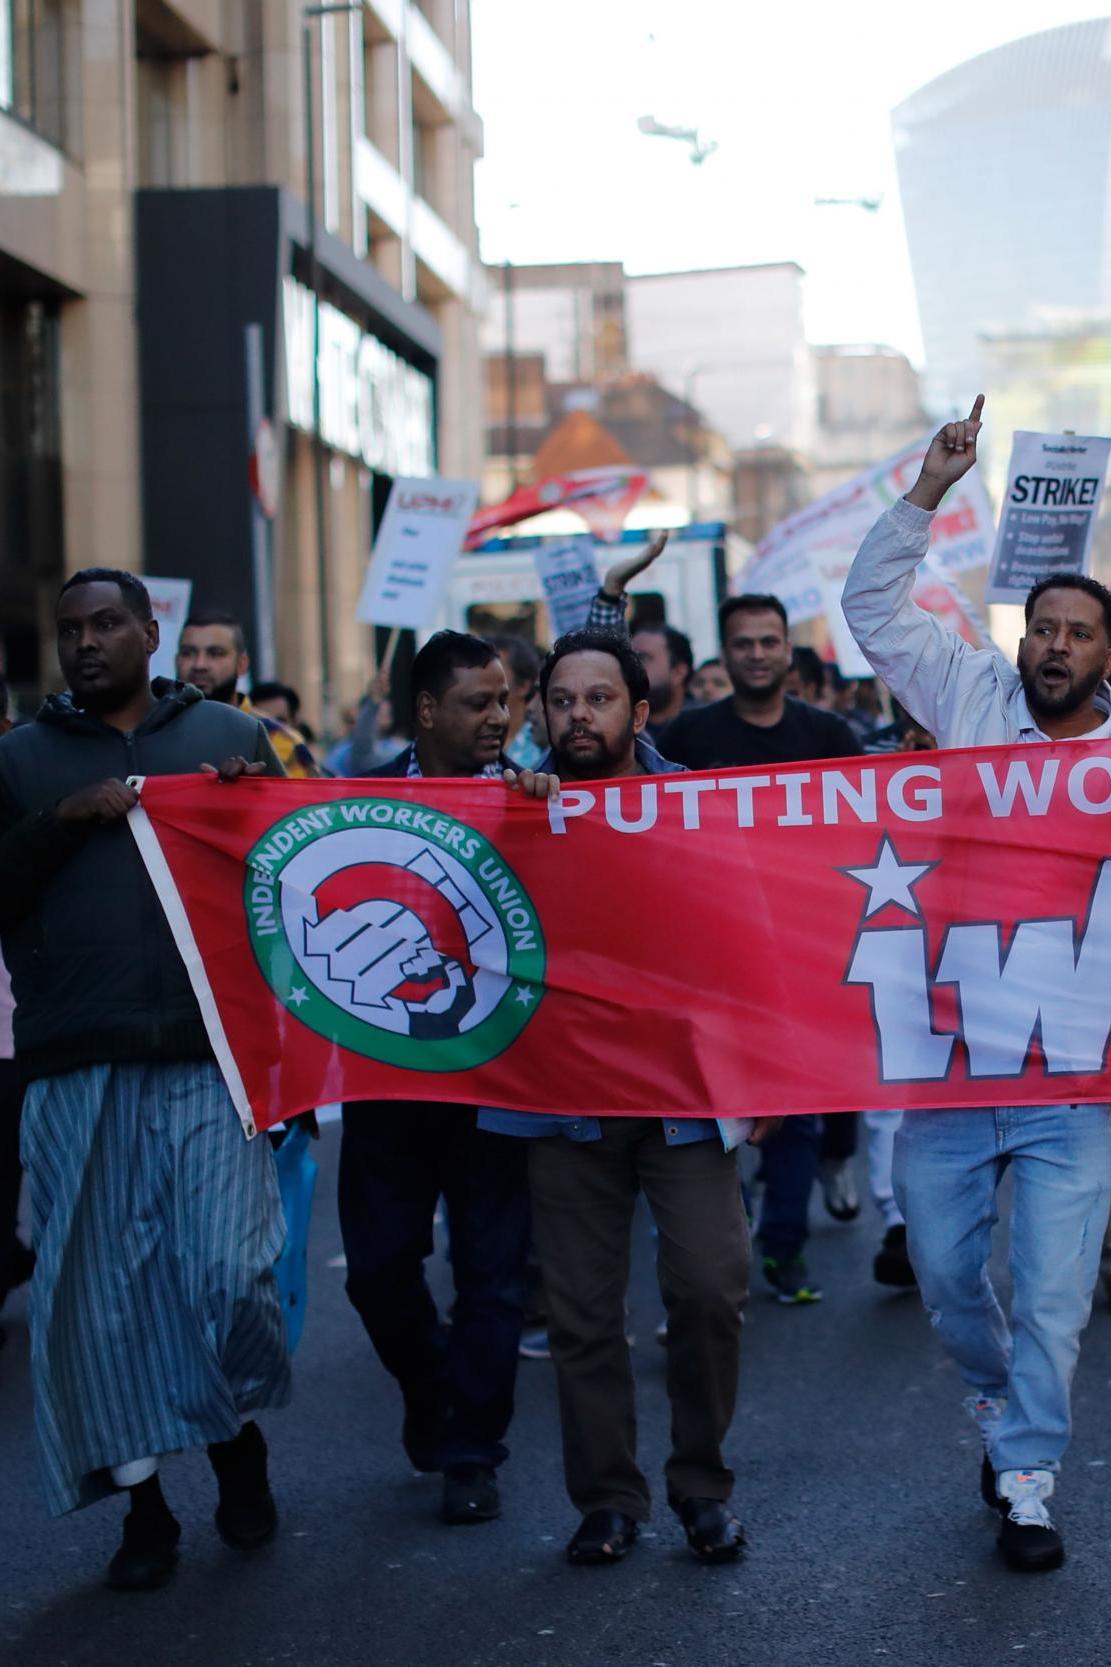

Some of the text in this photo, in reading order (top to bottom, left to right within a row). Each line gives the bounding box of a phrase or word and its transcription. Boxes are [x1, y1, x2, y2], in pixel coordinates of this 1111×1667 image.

[1011, 475, 1100, 506] STRIKE!
[547, 764, 943, 835] PUTTING
[340, 804, 481, 860] WORKERS
[478, 857, 537, 951] UNION
